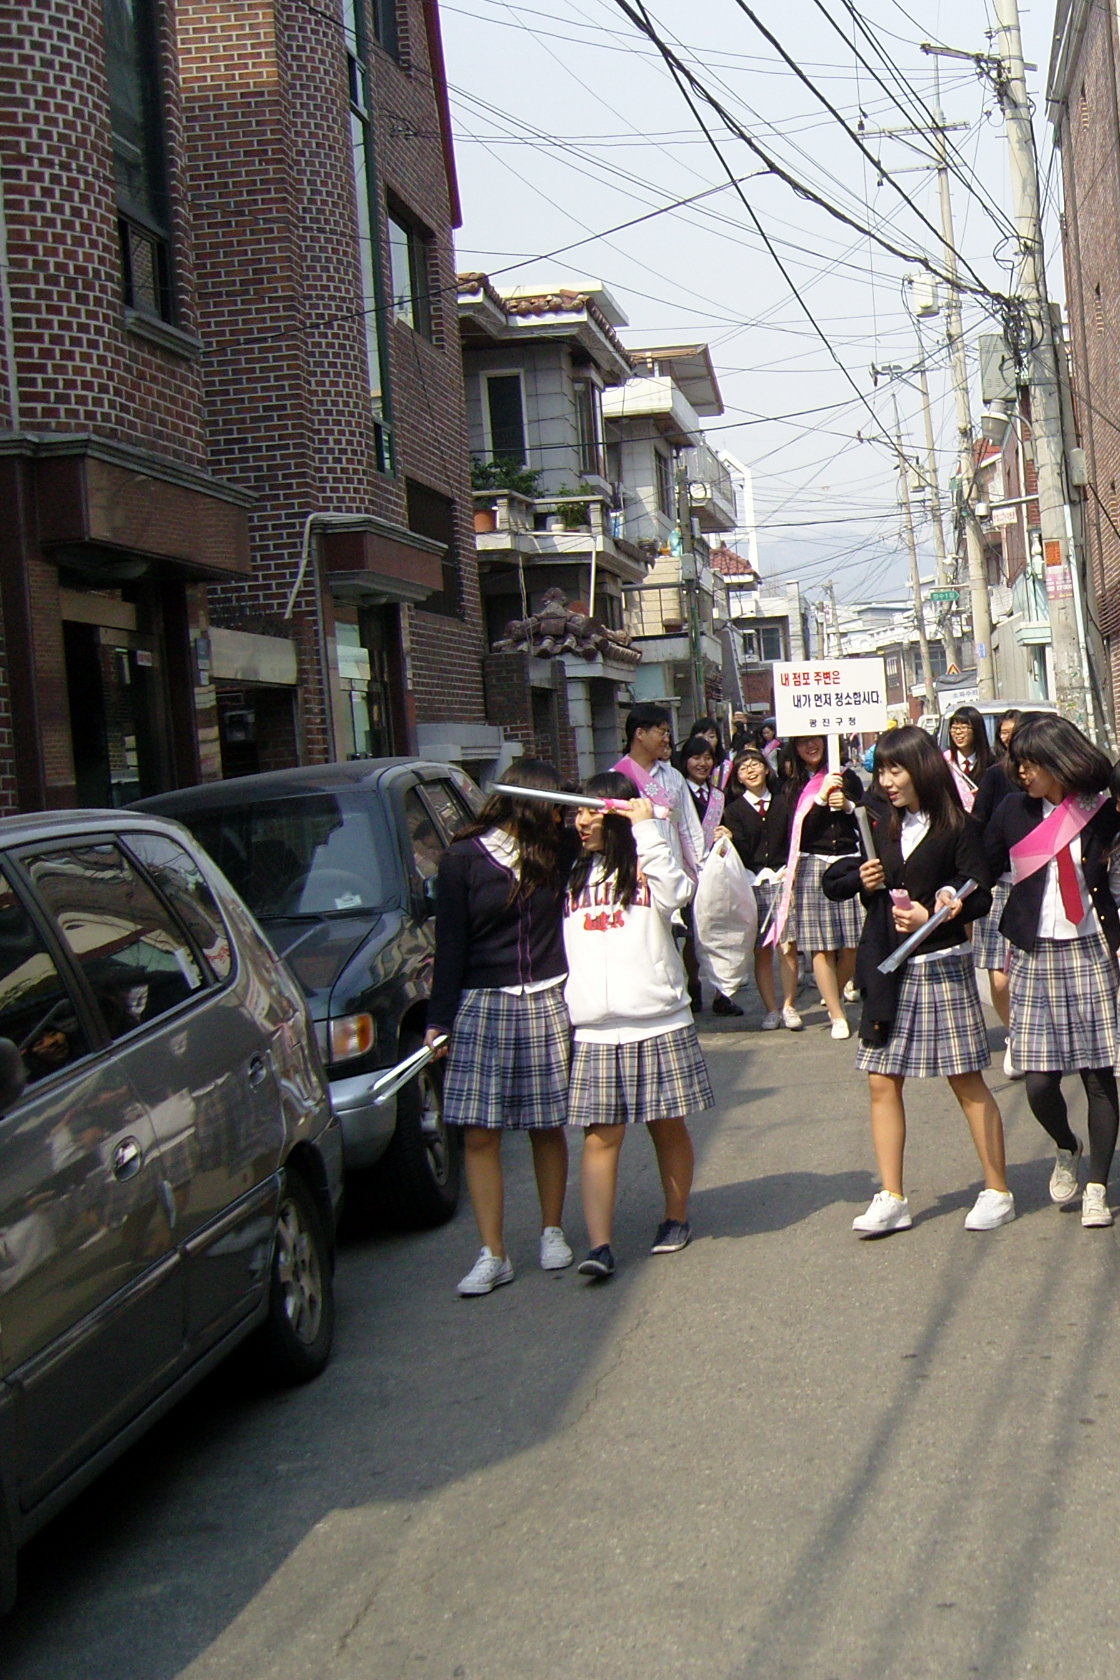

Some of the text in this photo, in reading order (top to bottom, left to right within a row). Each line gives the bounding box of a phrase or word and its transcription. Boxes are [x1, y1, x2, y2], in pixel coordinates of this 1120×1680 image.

[780, 670, 841, 687] 내 점포 주변은
[792, 693, 811, 708] 내가
[814, 692, 832, 708] 먼저
